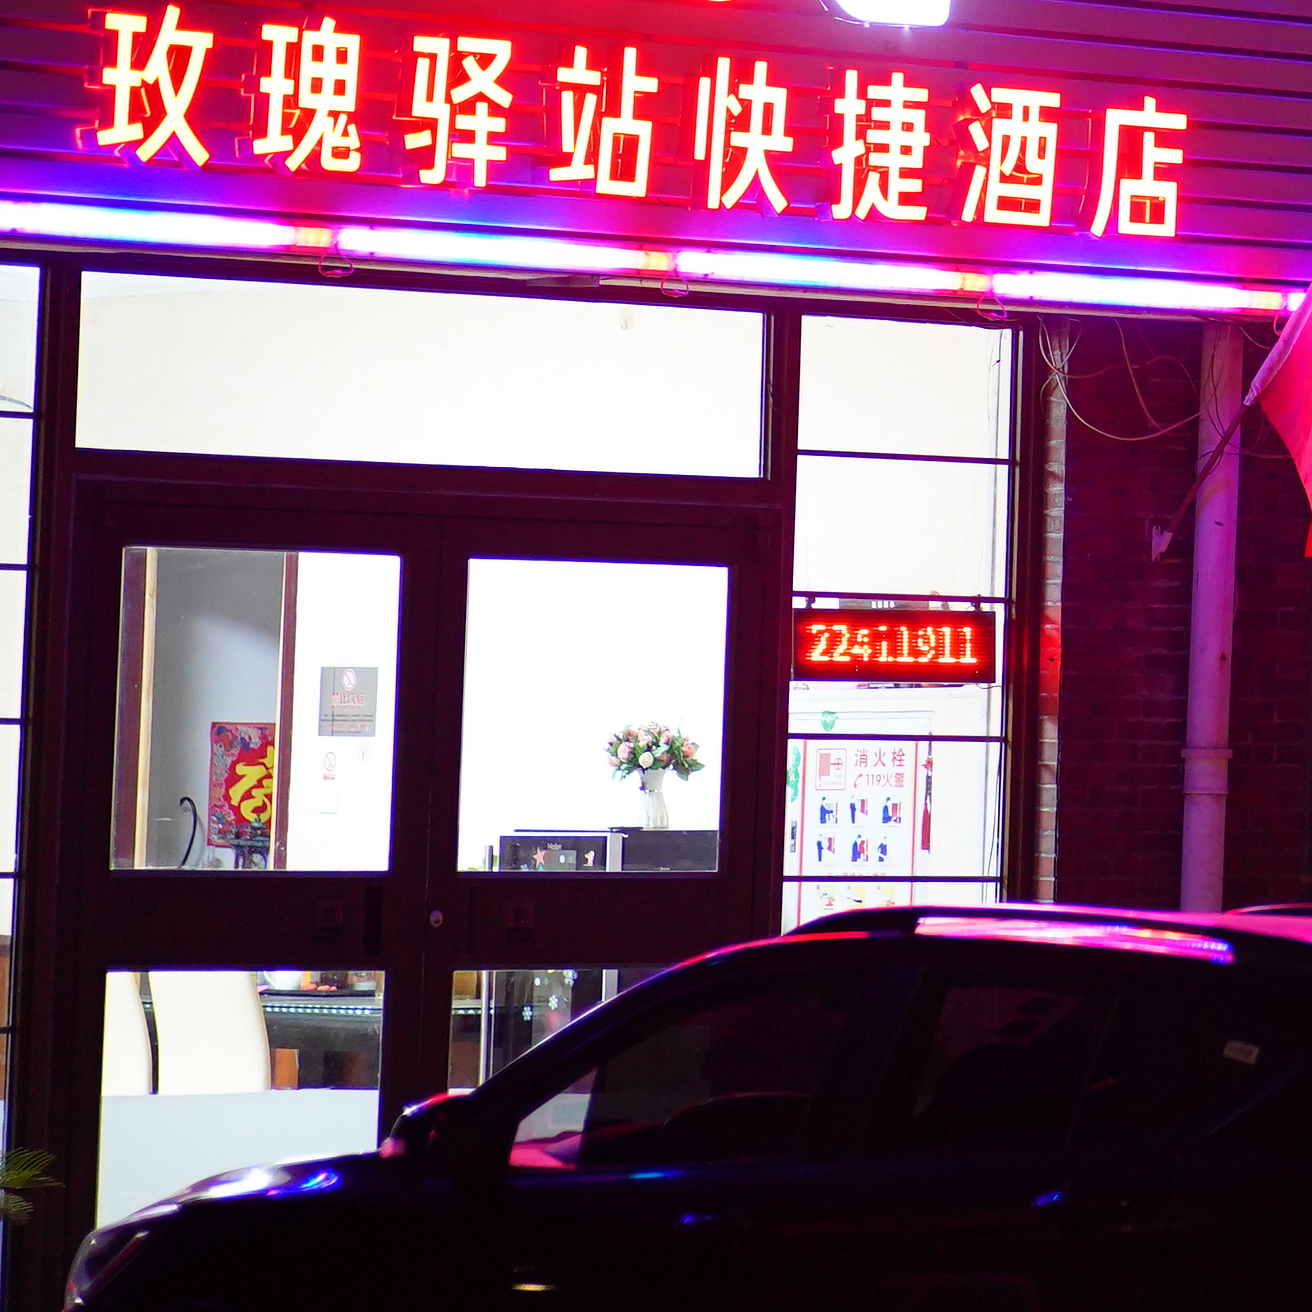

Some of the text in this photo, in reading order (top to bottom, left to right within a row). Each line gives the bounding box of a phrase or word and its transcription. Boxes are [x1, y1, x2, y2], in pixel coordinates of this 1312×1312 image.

[96, 3, 1188, 239] 玫瑰驿站快捷酒店
[854, 748, 906, 768] 消火栓
[865, 772, 905, 788] 119火警
